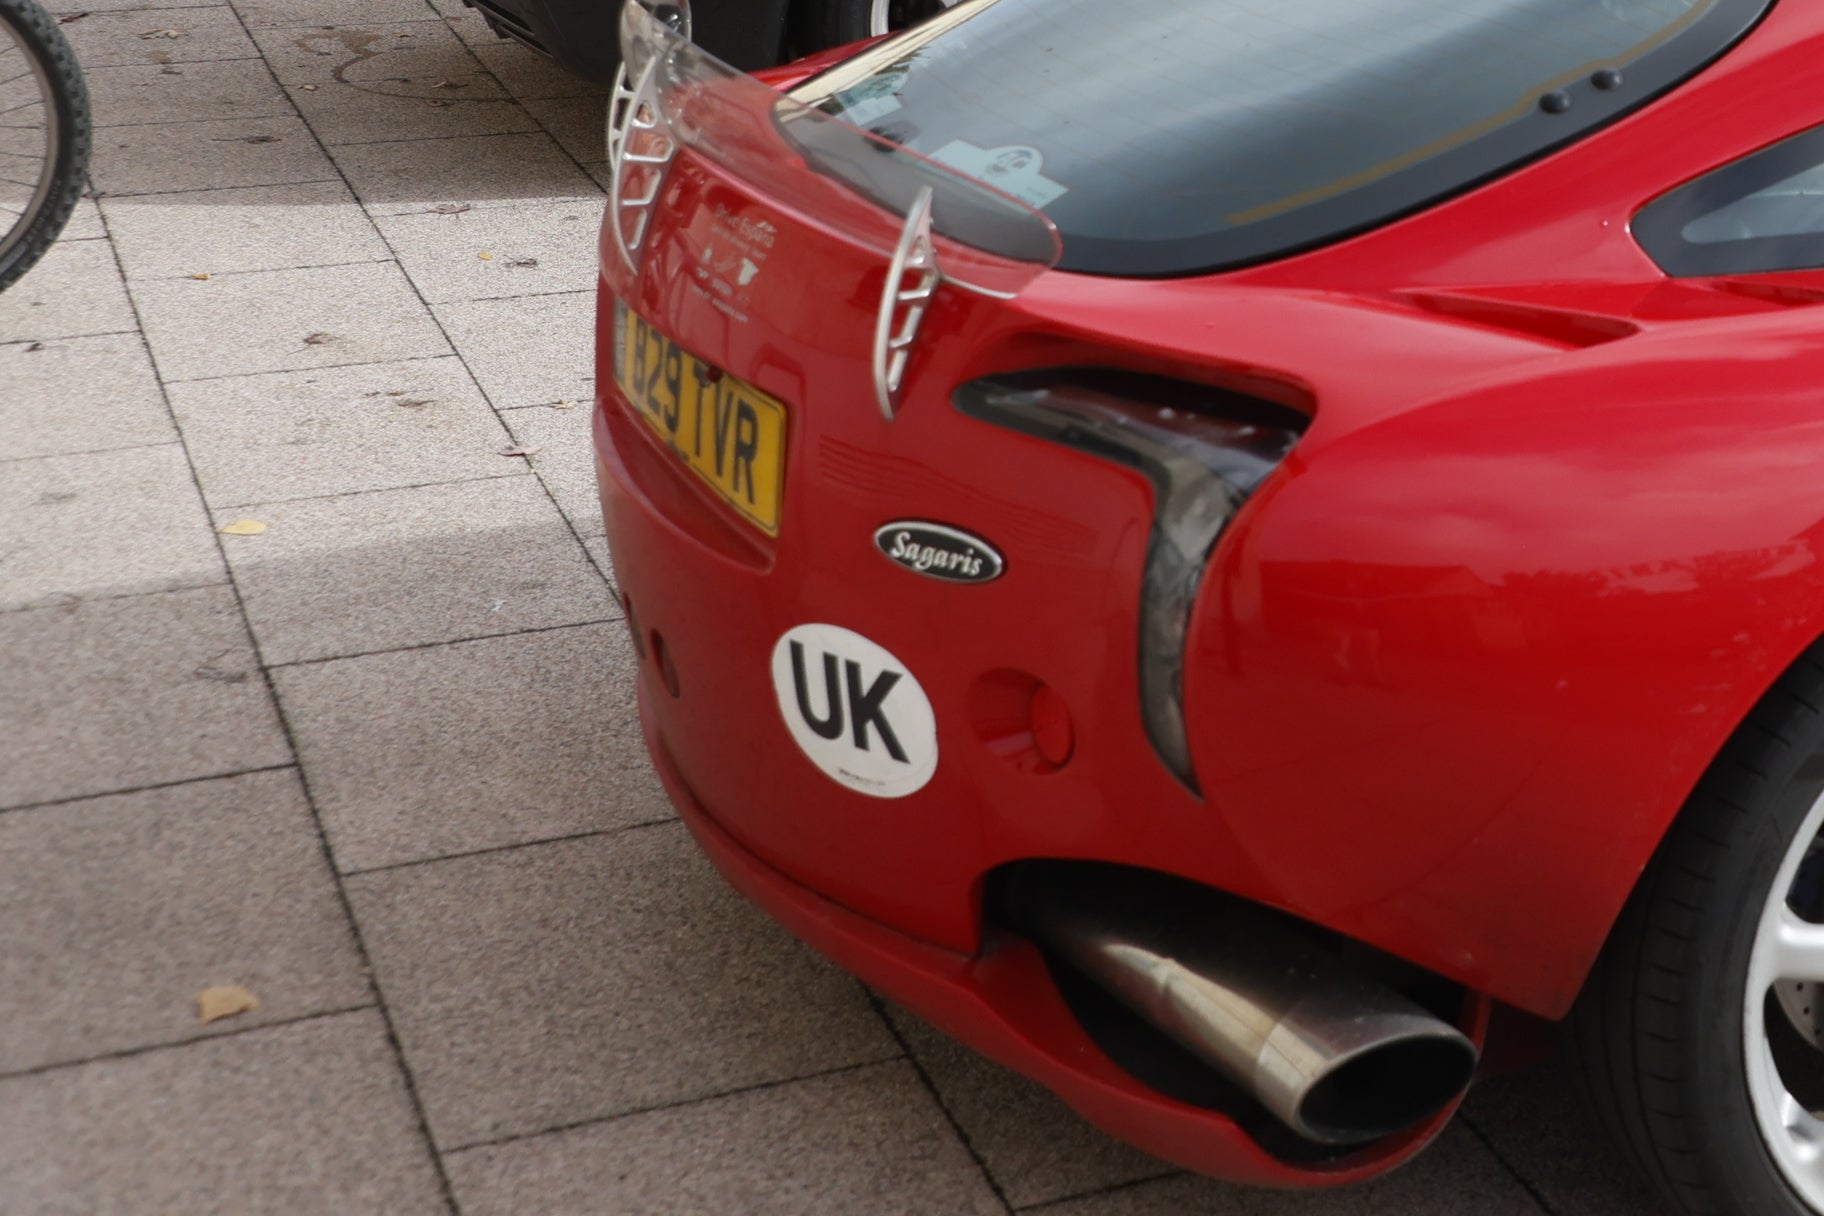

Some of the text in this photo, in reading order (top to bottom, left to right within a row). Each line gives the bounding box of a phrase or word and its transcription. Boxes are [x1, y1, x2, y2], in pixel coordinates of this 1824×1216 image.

[693, 359, 760, 506] TVR
[890, 530, 984, 577] Sagaris
[790, 639, 911, 765] UK
